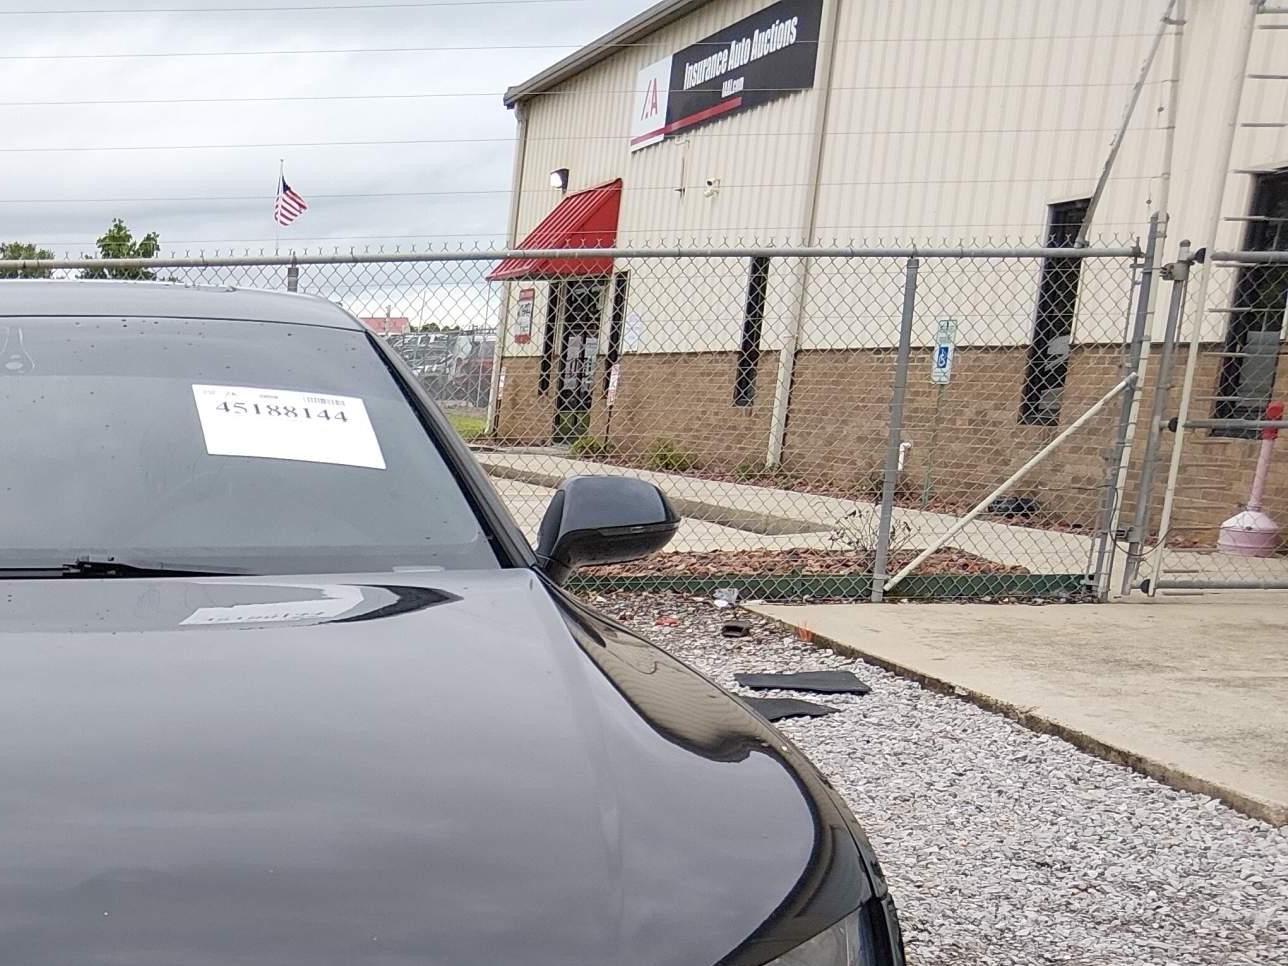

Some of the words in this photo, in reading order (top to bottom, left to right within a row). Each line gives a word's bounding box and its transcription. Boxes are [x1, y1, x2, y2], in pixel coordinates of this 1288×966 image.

[683, 48, 729, 91] Insurance
[727, 37, 751, 72] Auto
[750, 16, 798, 62] Auctions
[215, 400, 349, 423] 45188144
